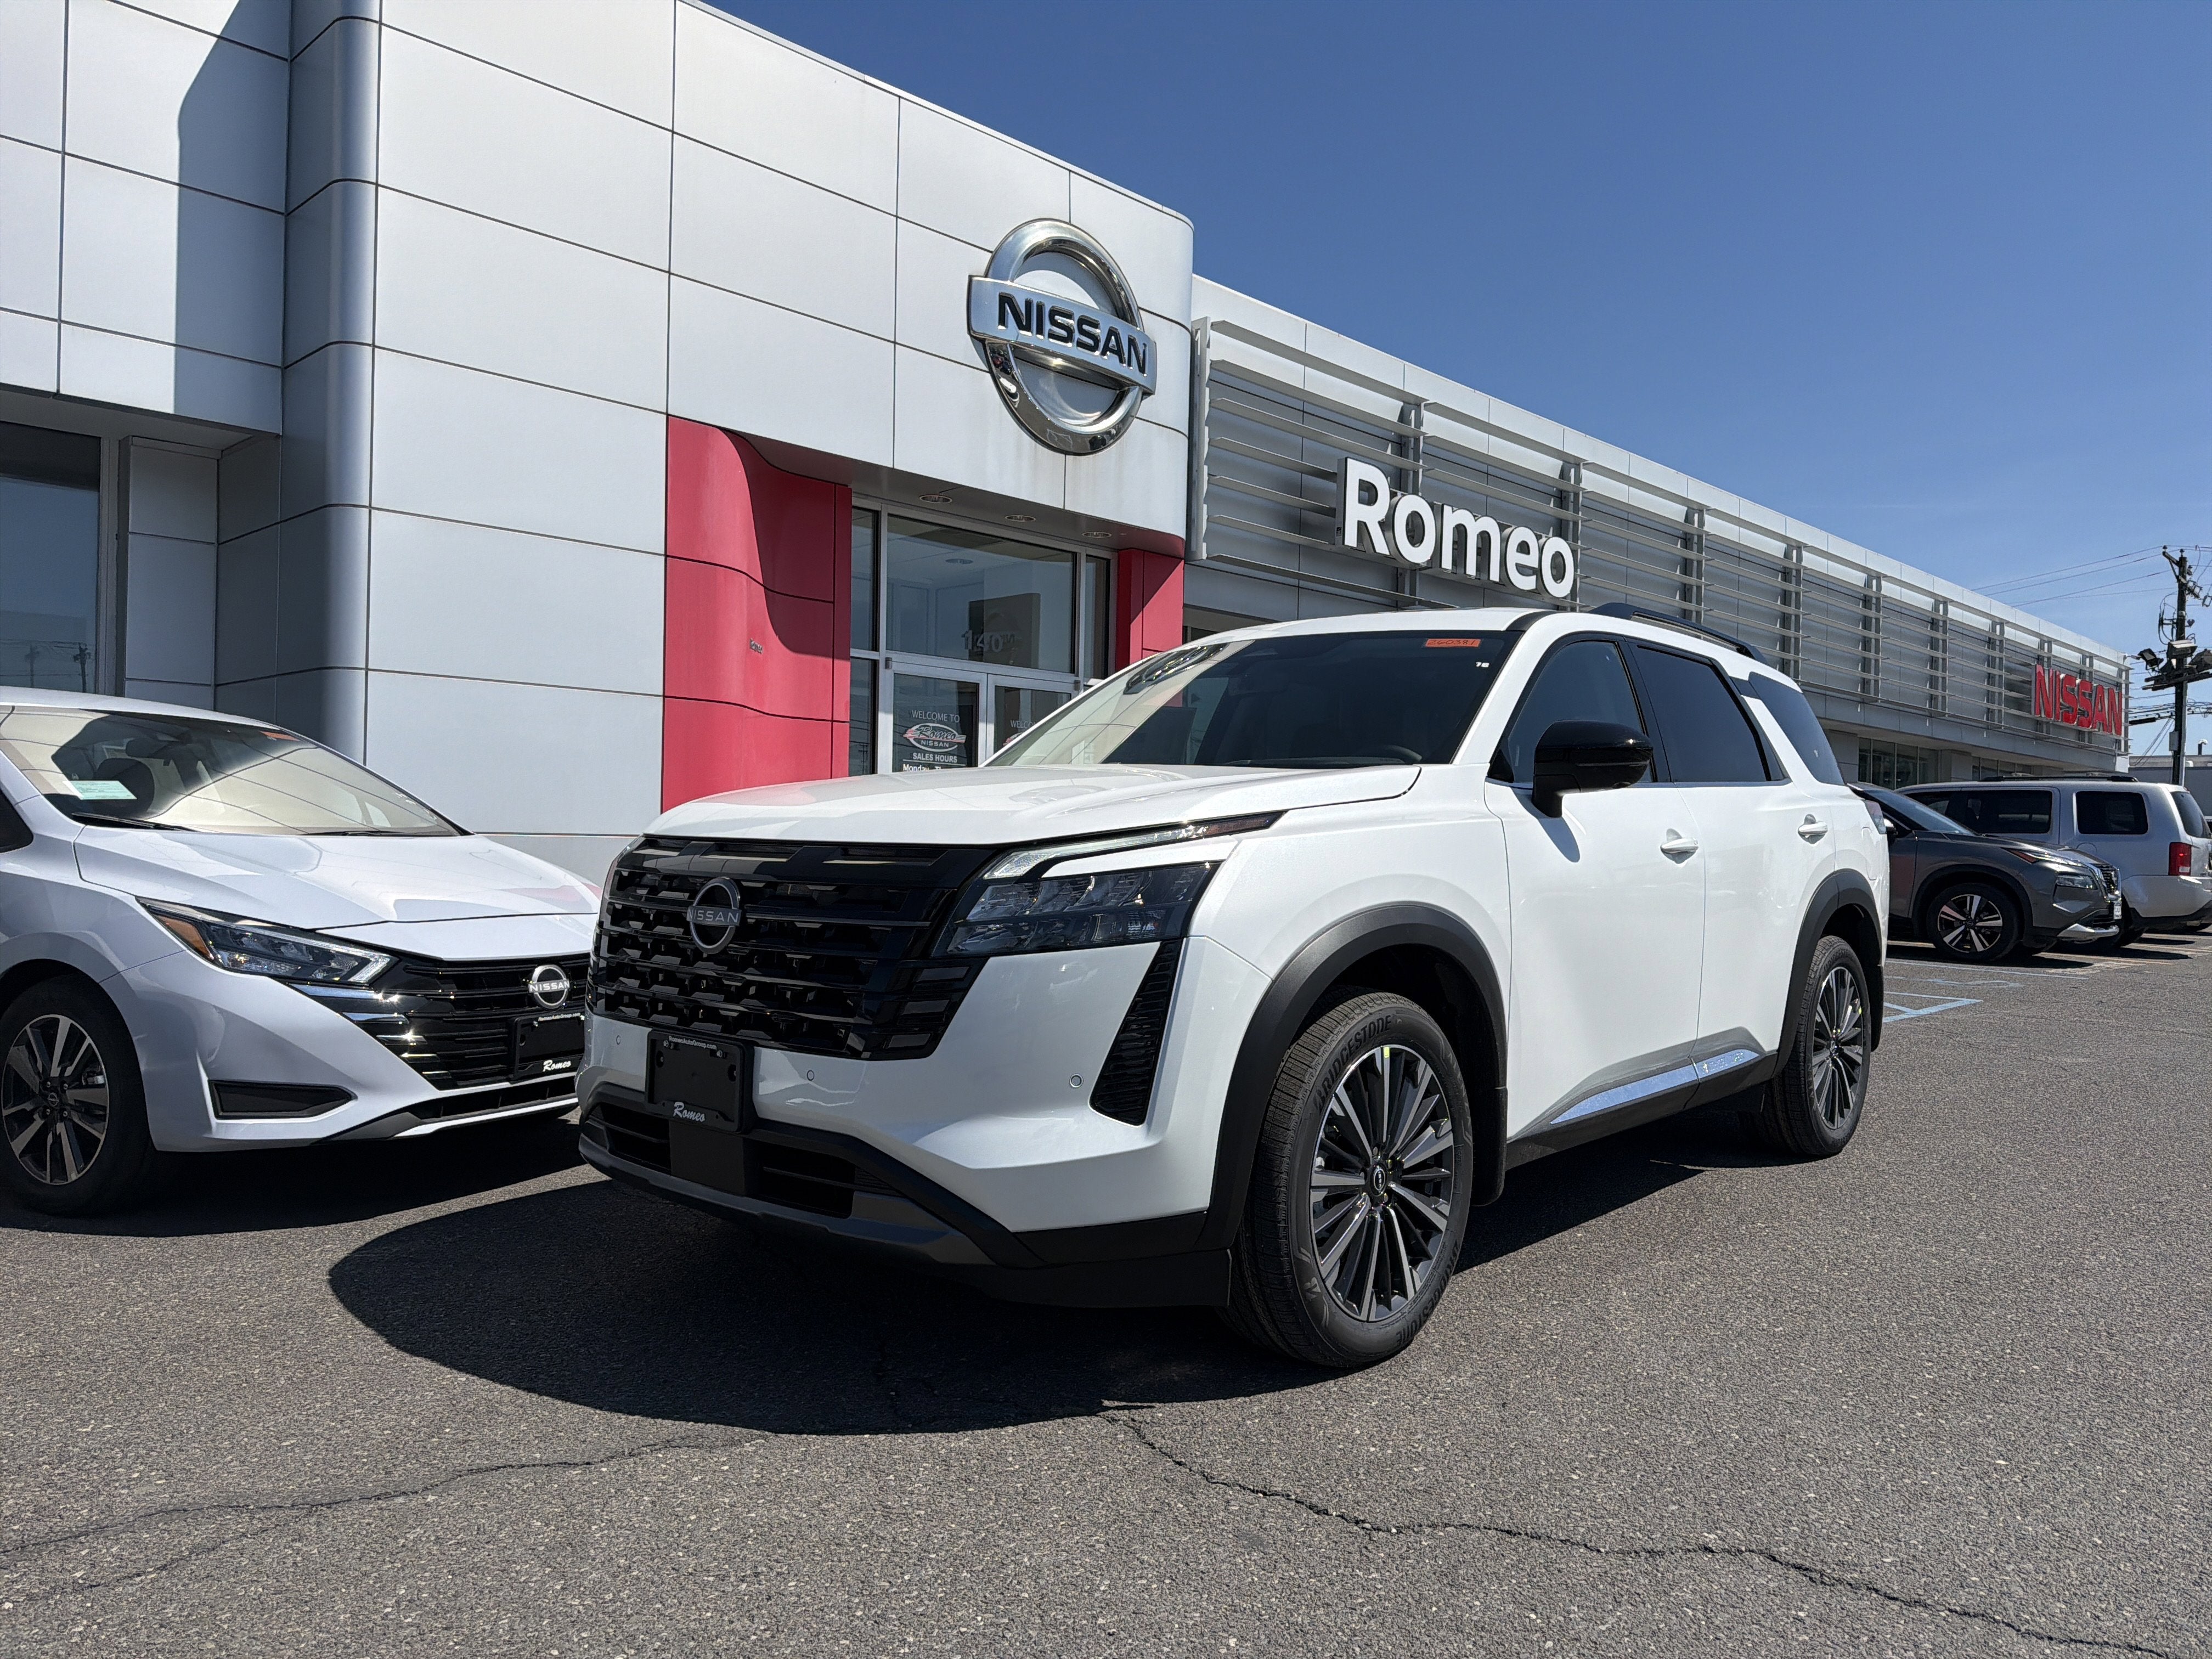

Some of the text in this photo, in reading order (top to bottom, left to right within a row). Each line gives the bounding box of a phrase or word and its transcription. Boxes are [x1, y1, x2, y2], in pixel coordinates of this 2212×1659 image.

[997, 292, 1147, 377] NISSAN
[1342, 456, 1575, 598] Romeo
[2035, 664, 2123, 736] NISSAN
[912, 710, 960, 723] WELCOME TO
[917, 724, 957, 741] Romeo
[912, 752, 957, 763] SALES HOURS
[689, 909, 738, 923] NISSAN
[529, 981, 569, 992] NISSAN
[543, 1059, 571, 1071] Romeo
[673, 1102, 706, 1122] Romeo
